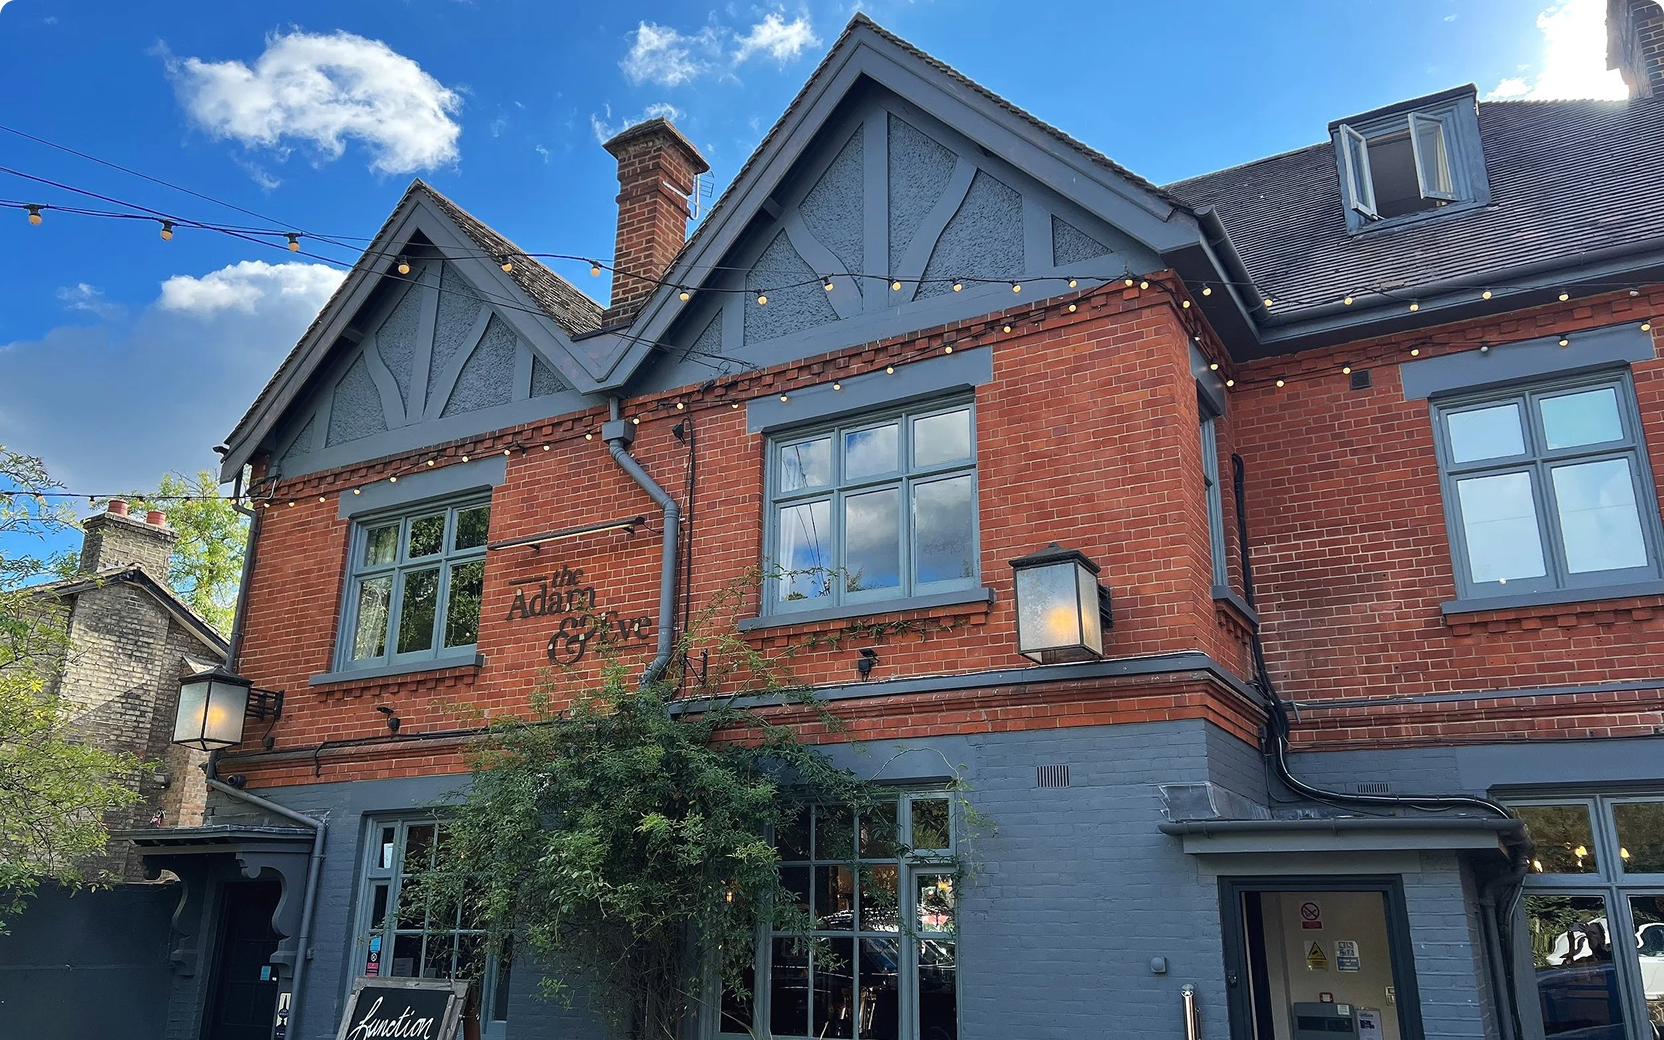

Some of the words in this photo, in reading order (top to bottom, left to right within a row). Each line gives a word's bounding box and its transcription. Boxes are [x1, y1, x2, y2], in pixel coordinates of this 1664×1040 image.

[551, 564, 584, 588] the
[505, 584, 596, 621] Adam
[547, 613, 597, 665] &
[596, 610, 652, 646] Eve
